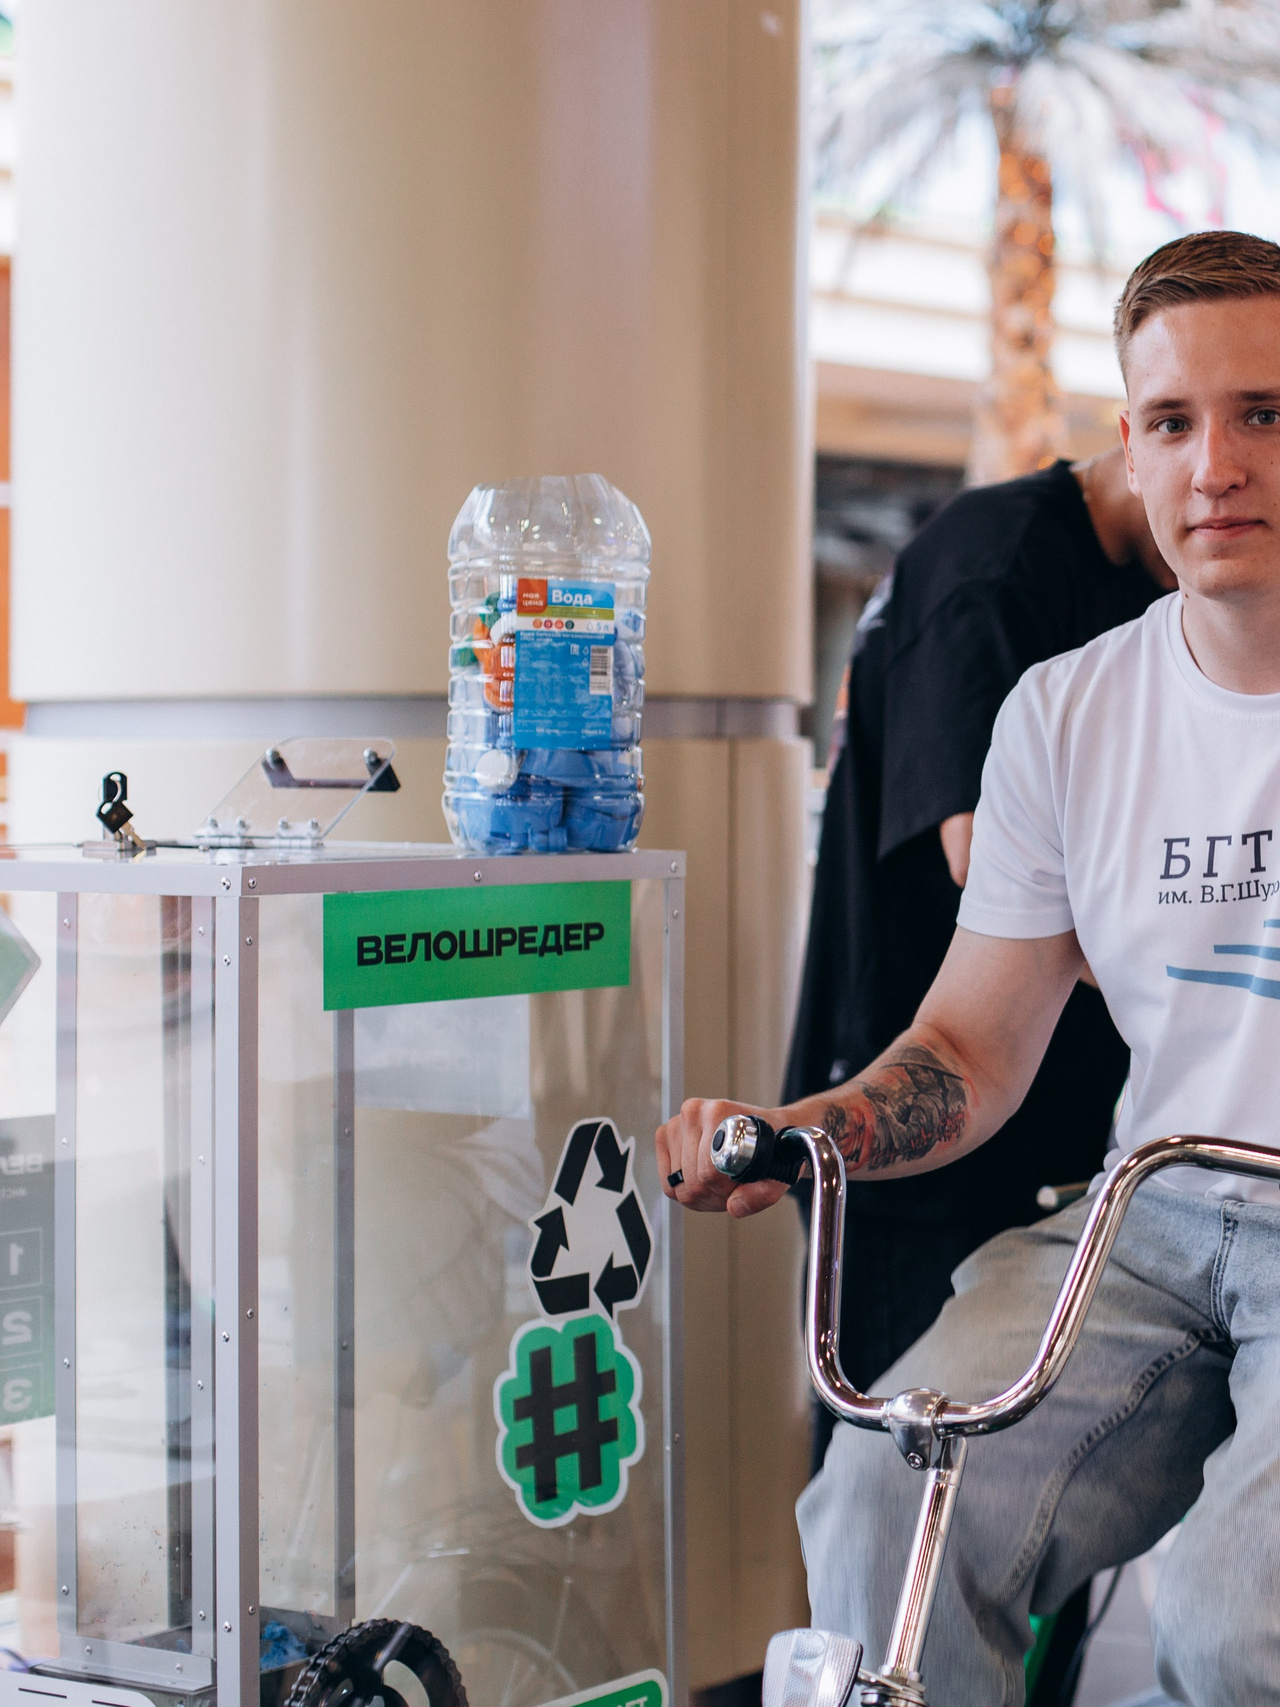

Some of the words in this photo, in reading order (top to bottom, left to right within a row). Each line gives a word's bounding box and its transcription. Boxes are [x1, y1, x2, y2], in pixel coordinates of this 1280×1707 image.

[551, 589, 593, 606] Вода
[1158, 890, 1192, 905] им.
[357, 921, 604, 966] ВЕЛОШРЕДЕР
